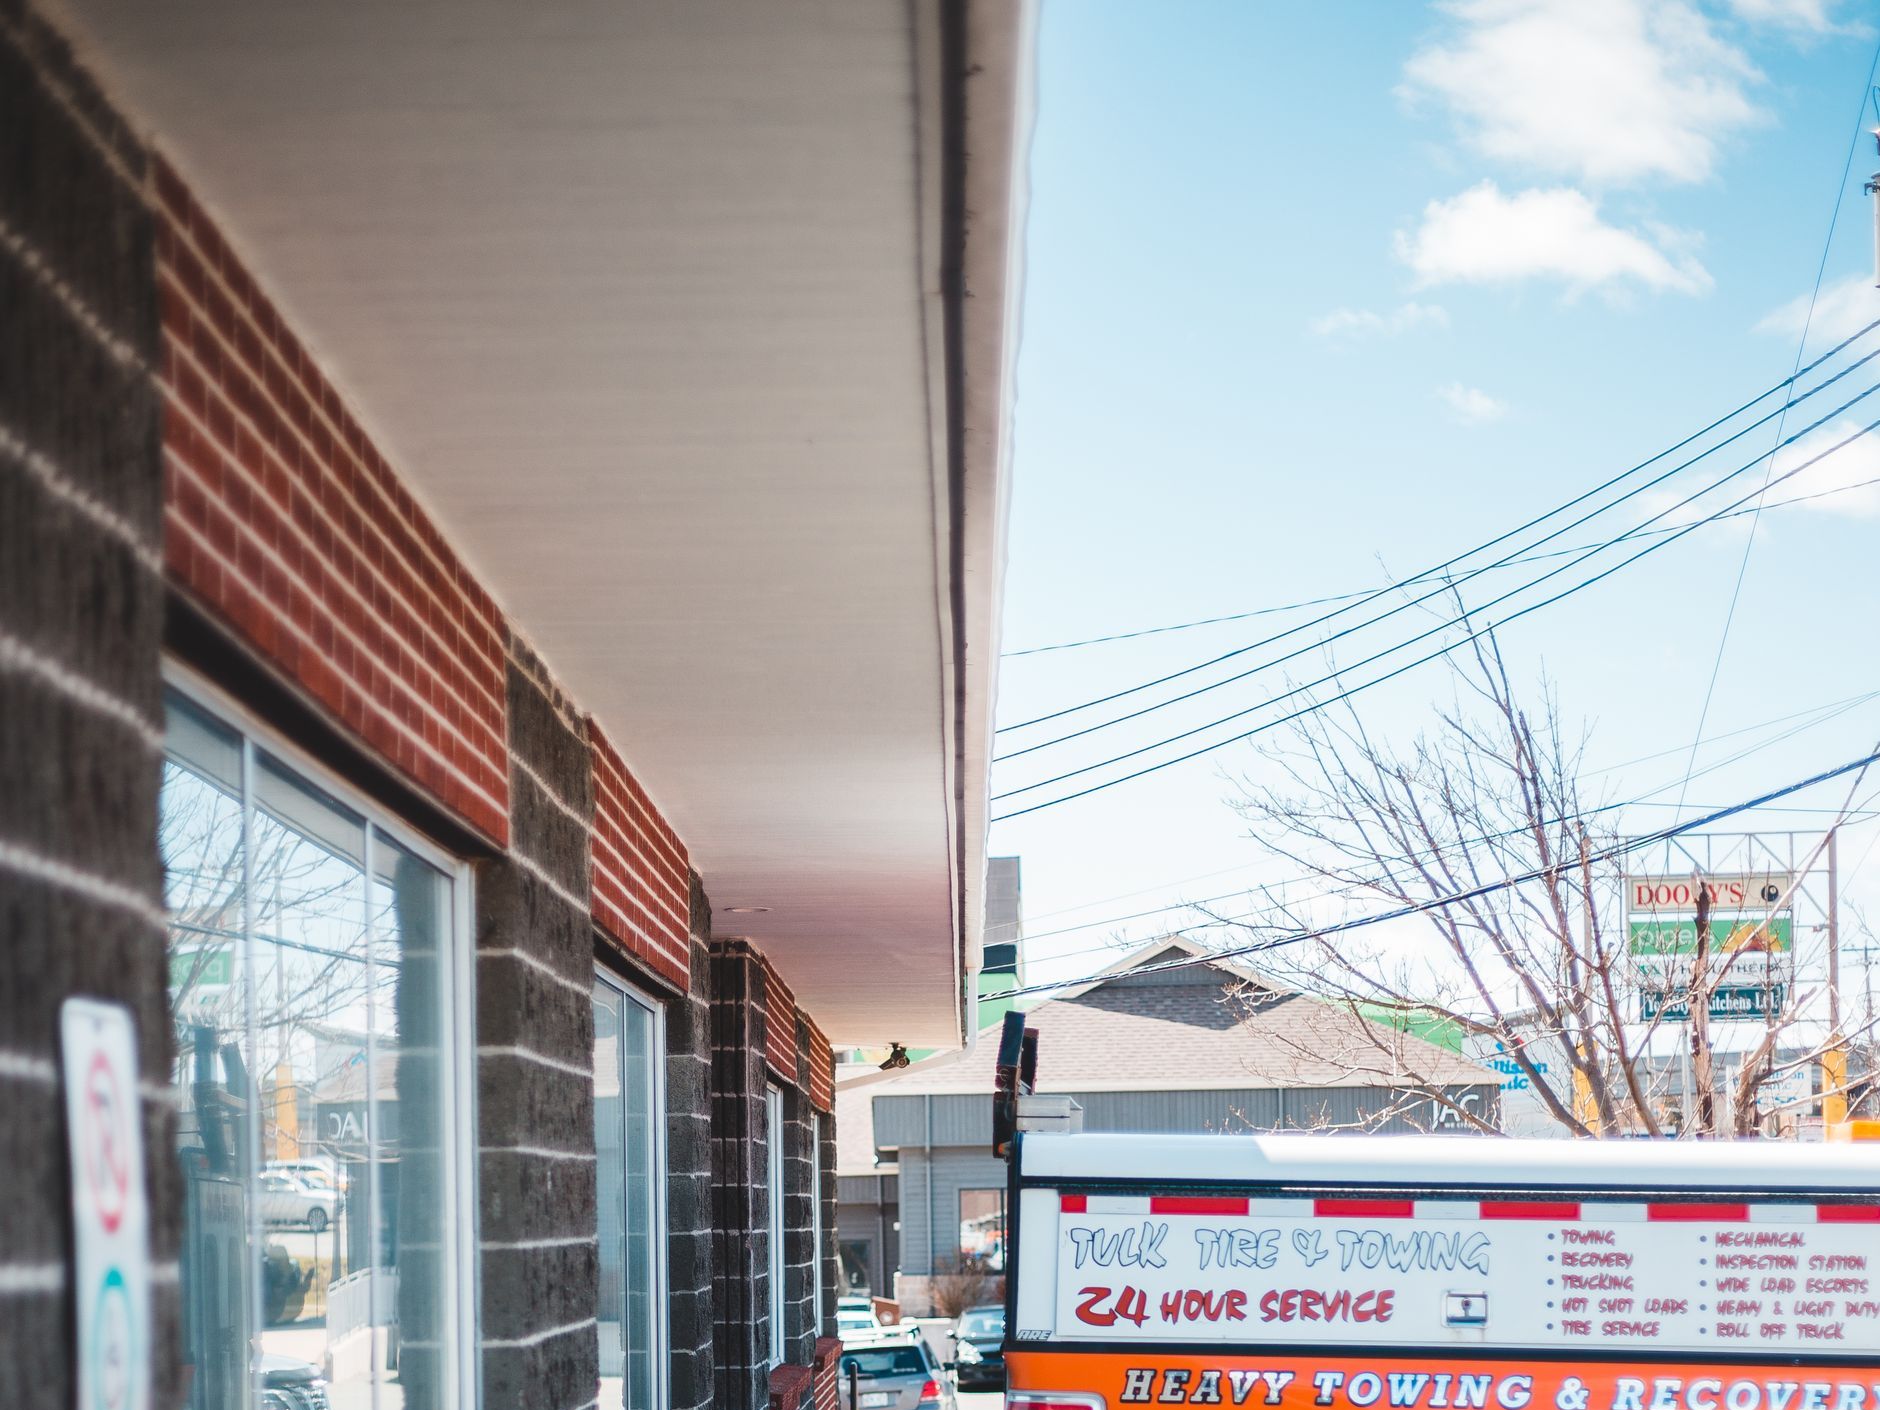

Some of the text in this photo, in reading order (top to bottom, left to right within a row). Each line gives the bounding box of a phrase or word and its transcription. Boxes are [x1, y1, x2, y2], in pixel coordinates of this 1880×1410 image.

[1636, 883, 1743, 905] DOOY'S
[1708, 993, 1752, 1011] itchens
[1561, 1229, 1615, 1245] TOWING
[1715, 1231, 1806, 1248] MECHANICAL
[1070, 1222, 1491, 1275] TULK TIRE & TOWING
[1561, 1252, 1633, 1269] RECOVERY
[1715, 1254, 1868, 1271] INSPECTION STATION
[1561, 1274, 1635, 1291] TRUCKING
[1716, 1277, 1869, 1294] WIDE LOAD ESCORTS
[1075, 1285, 1395, 1328] 24 HOUR SERVICE
[1562, 1299, 1689, 1315] HOT SHOT LOADS
[1717, 1300, 1880, 1318] HEAVY & LIGHT DUTY
[1562, 1320, 1661, 1336] TIRE SERVICE
[1717, 1322, 1845, 1340] ROLL OFF TRUCK
[1121, 1369, 1294, 1403] HEAVY
[1315, 1371, 1532, 1410] TOWING
[1556, 1377, 1590, 1410] &
